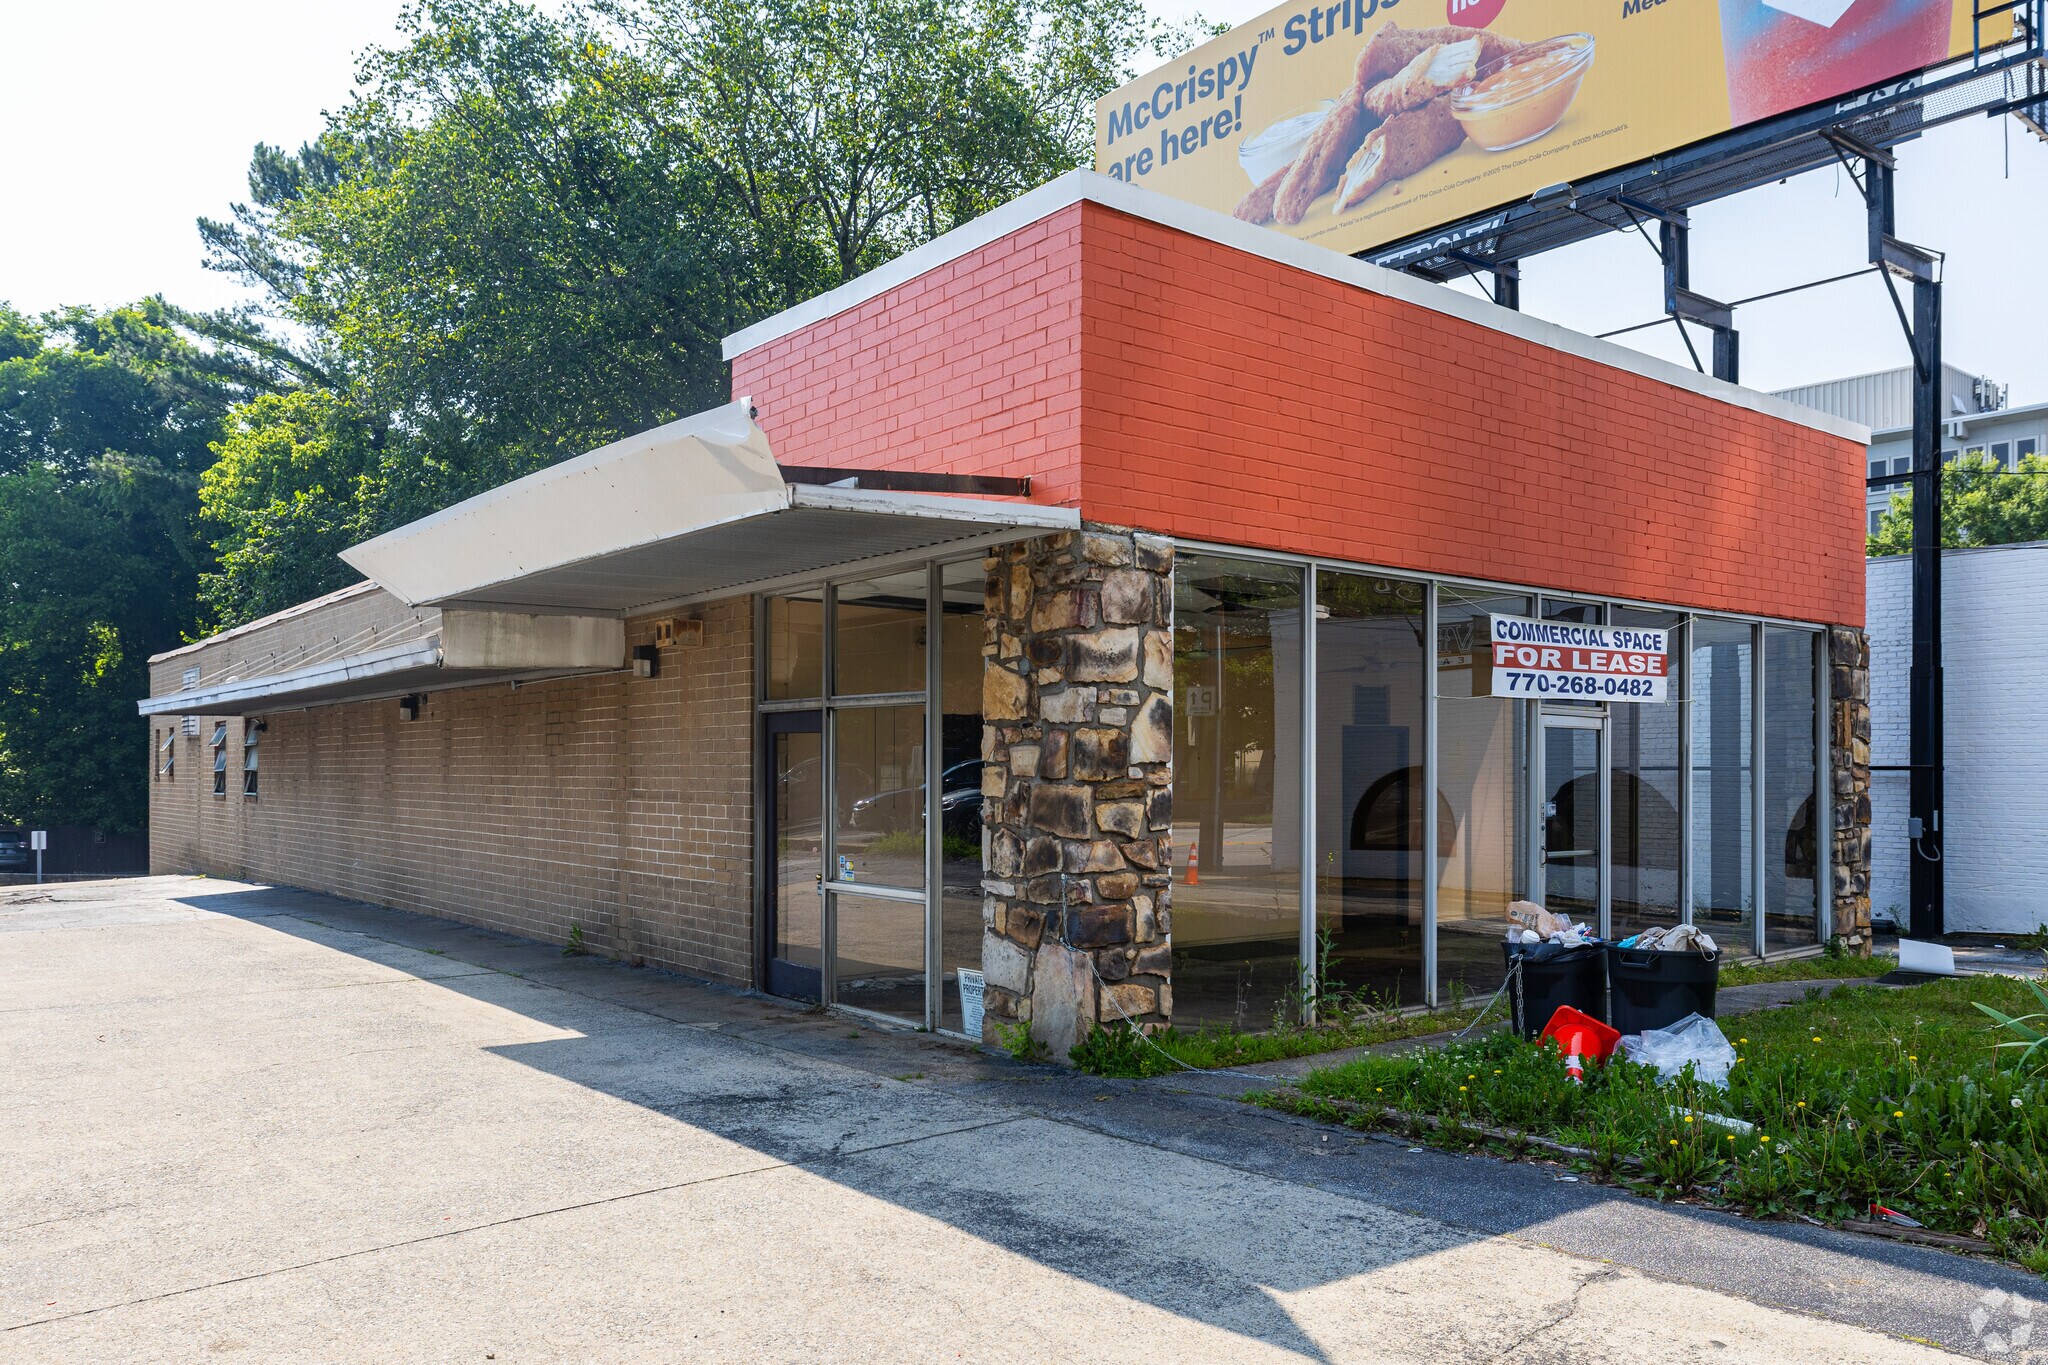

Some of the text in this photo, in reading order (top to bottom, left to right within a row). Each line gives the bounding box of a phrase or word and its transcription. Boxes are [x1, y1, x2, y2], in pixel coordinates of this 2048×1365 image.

[1283, 0, 1400, 56] Strip
[1108, 94, 1242, 182] are here!
[1363, 206, 1387, 219] registered
[1387, 198, 1412, 212] trademark
[1428, 183, 1456, 197] Coca-Cola
[1501, 164, 1512, 172] The
[1512, 153, 1542, 168] Coca-Cola
[1496, 619, 1610, 648] COMMERCIAL
[1612, 630, 1662, 651] SPACE
[1496, 645, 1662, 674] FOR LEASE
[1506, 672, 1654, 697] 770-268-0482
